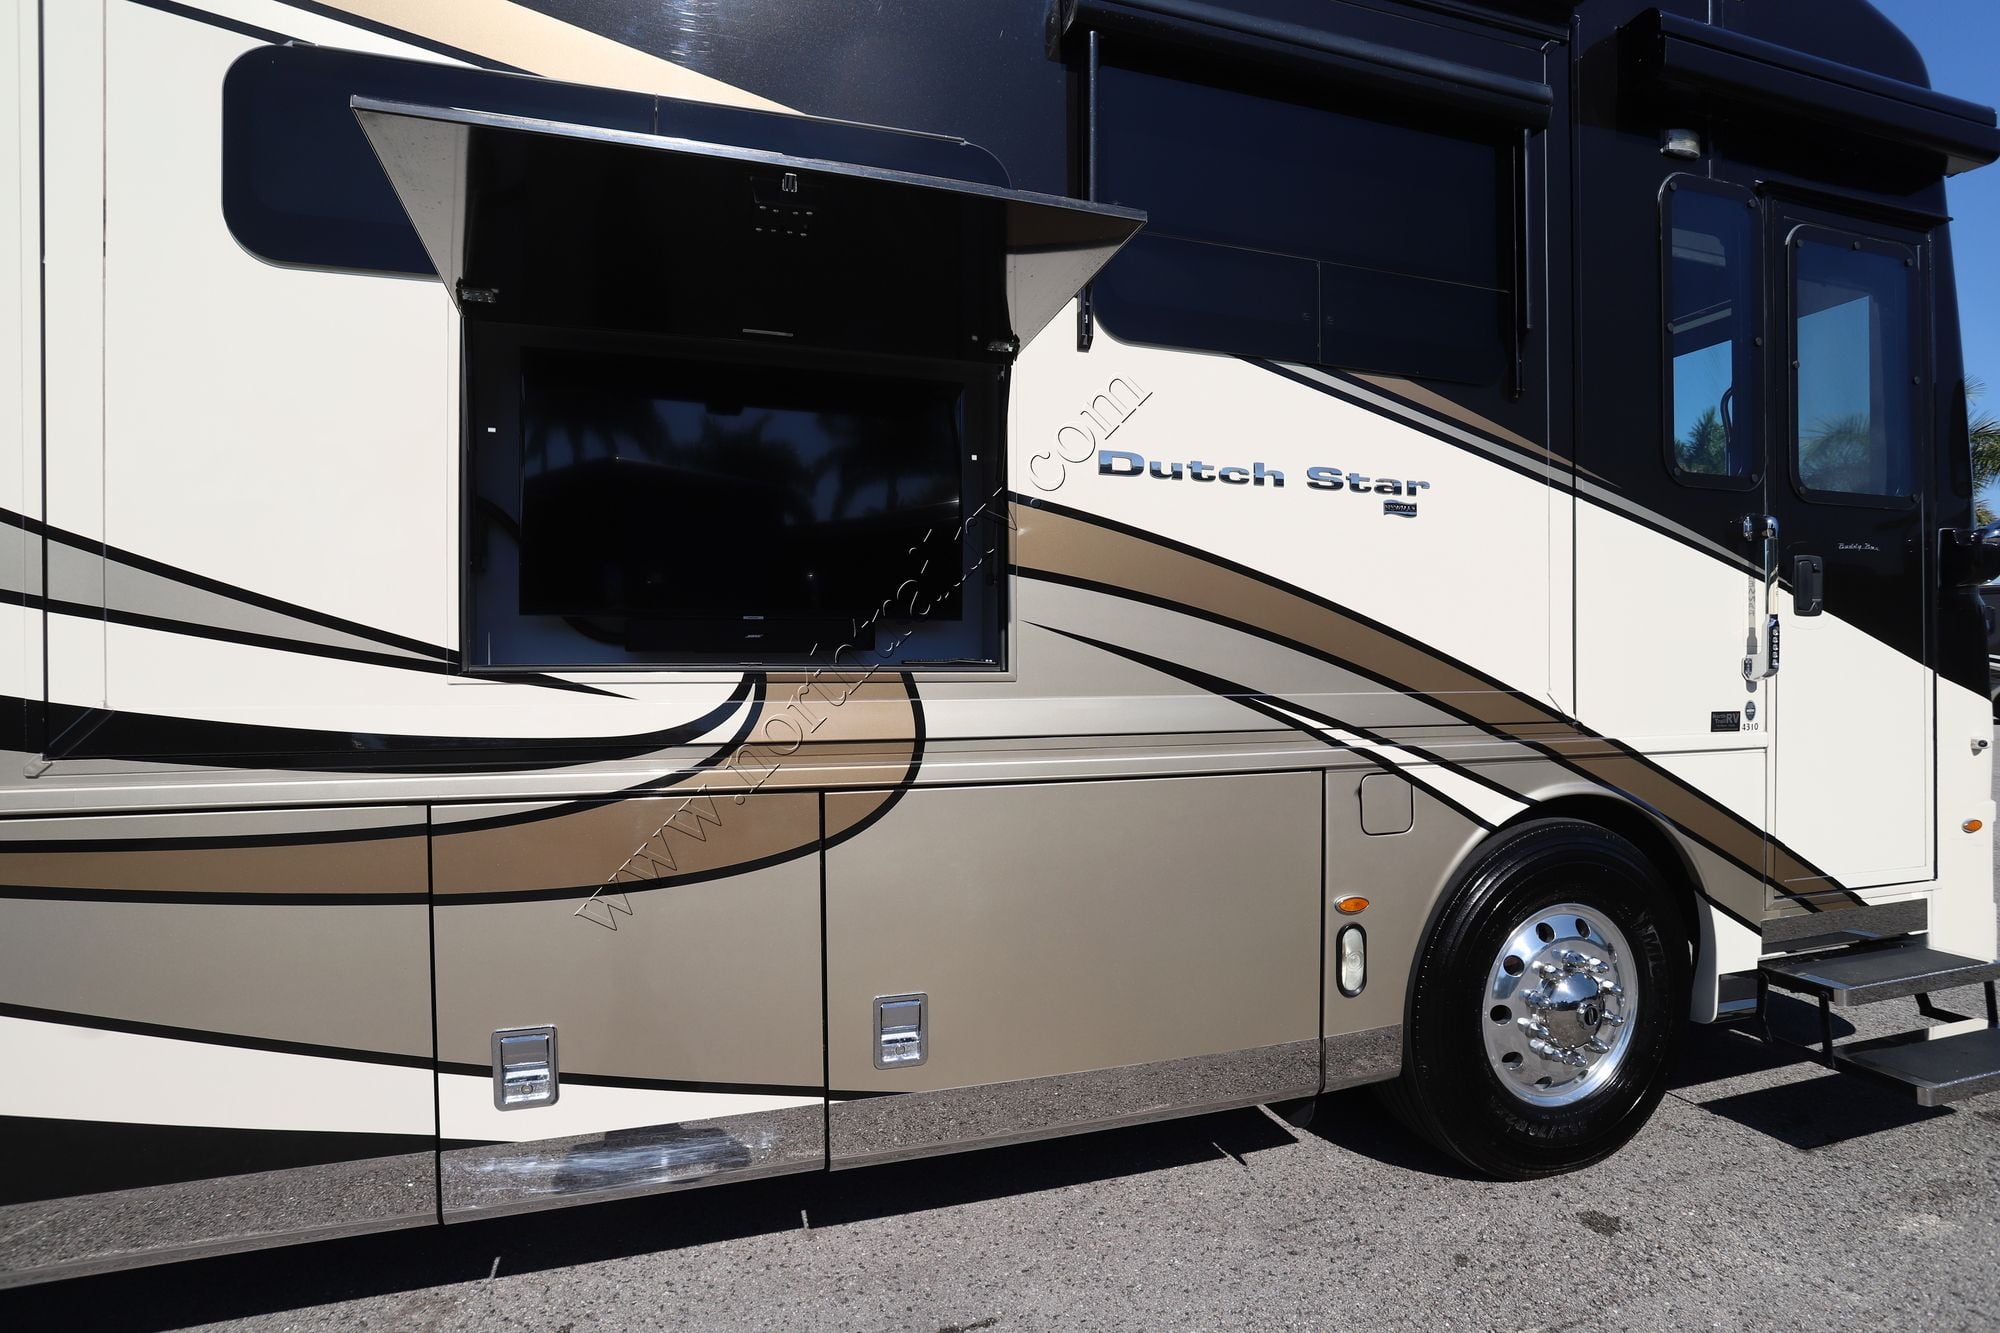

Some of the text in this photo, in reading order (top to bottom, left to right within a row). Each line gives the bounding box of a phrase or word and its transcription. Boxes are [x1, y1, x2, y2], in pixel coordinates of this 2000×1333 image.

[1098, 450, 1431, 496] Dutch Star
[1726, 713, 1740, 724] RV
